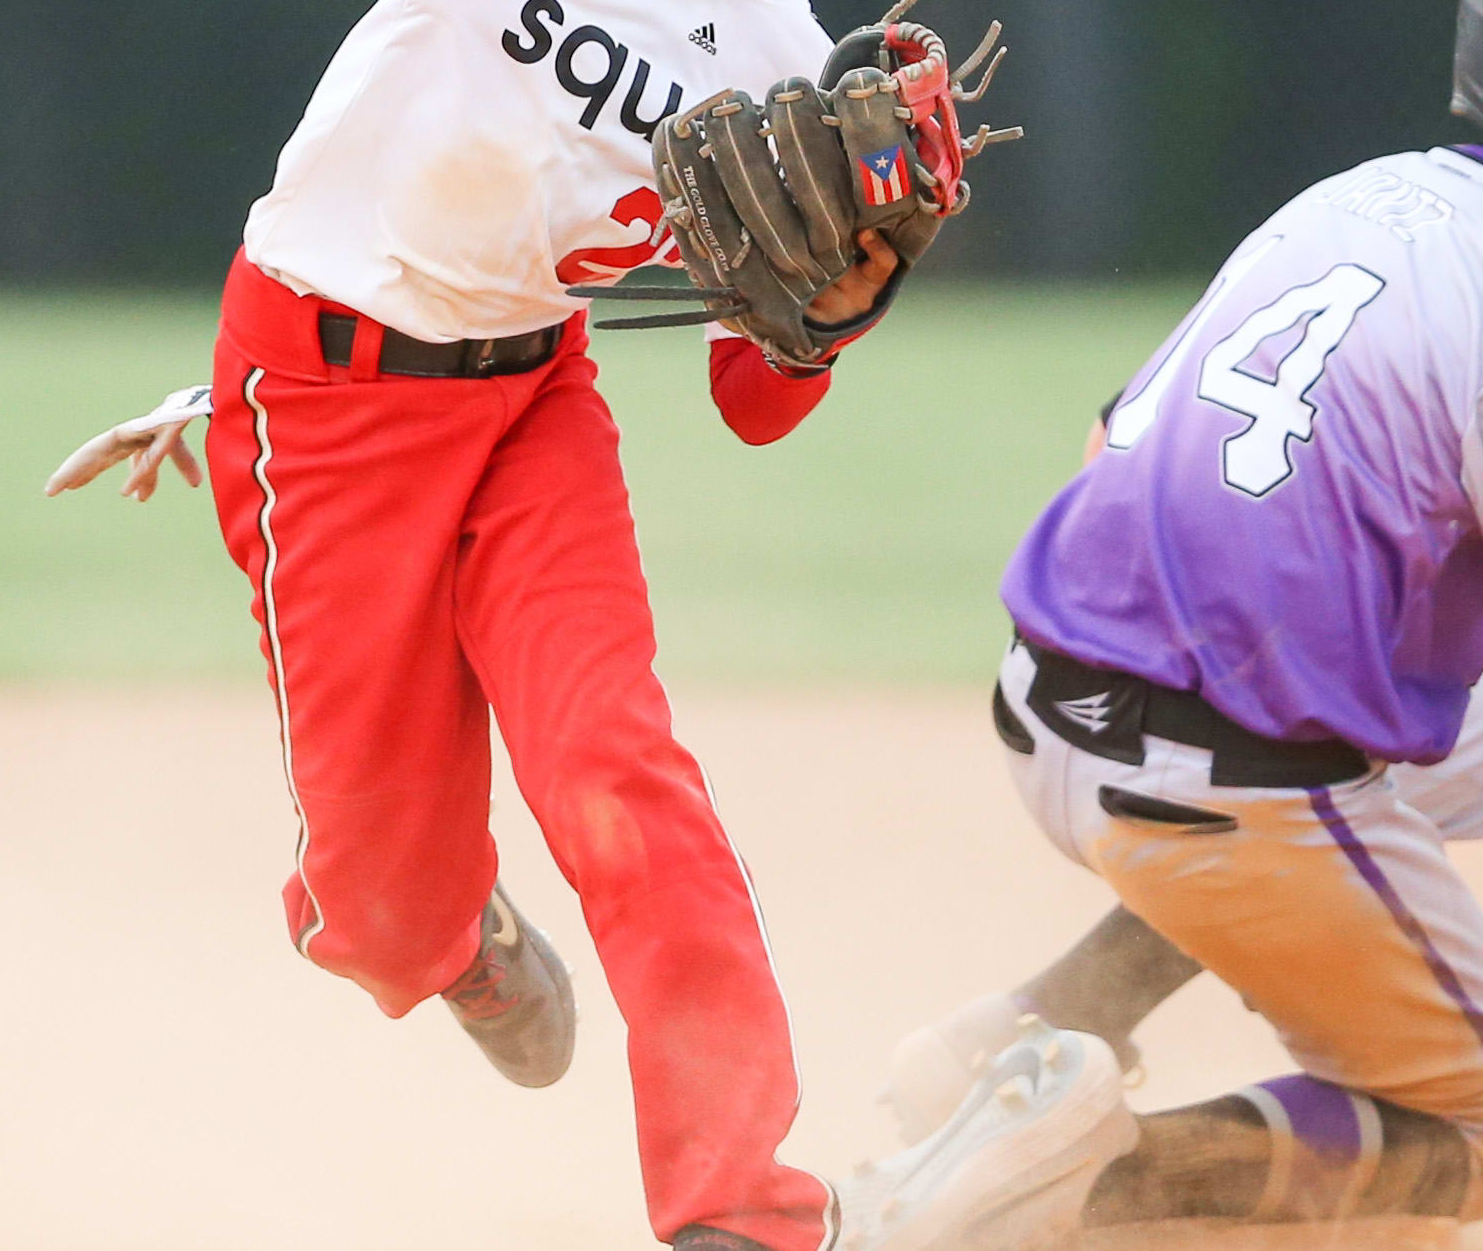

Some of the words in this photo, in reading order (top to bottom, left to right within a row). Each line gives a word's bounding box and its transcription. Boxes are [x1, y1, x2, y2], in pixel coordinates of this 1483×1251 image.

[684, 165, 697, 187] THE
[690, 188, 706, 215] GOLD
[700, 216, 720, 247] GLOVE
